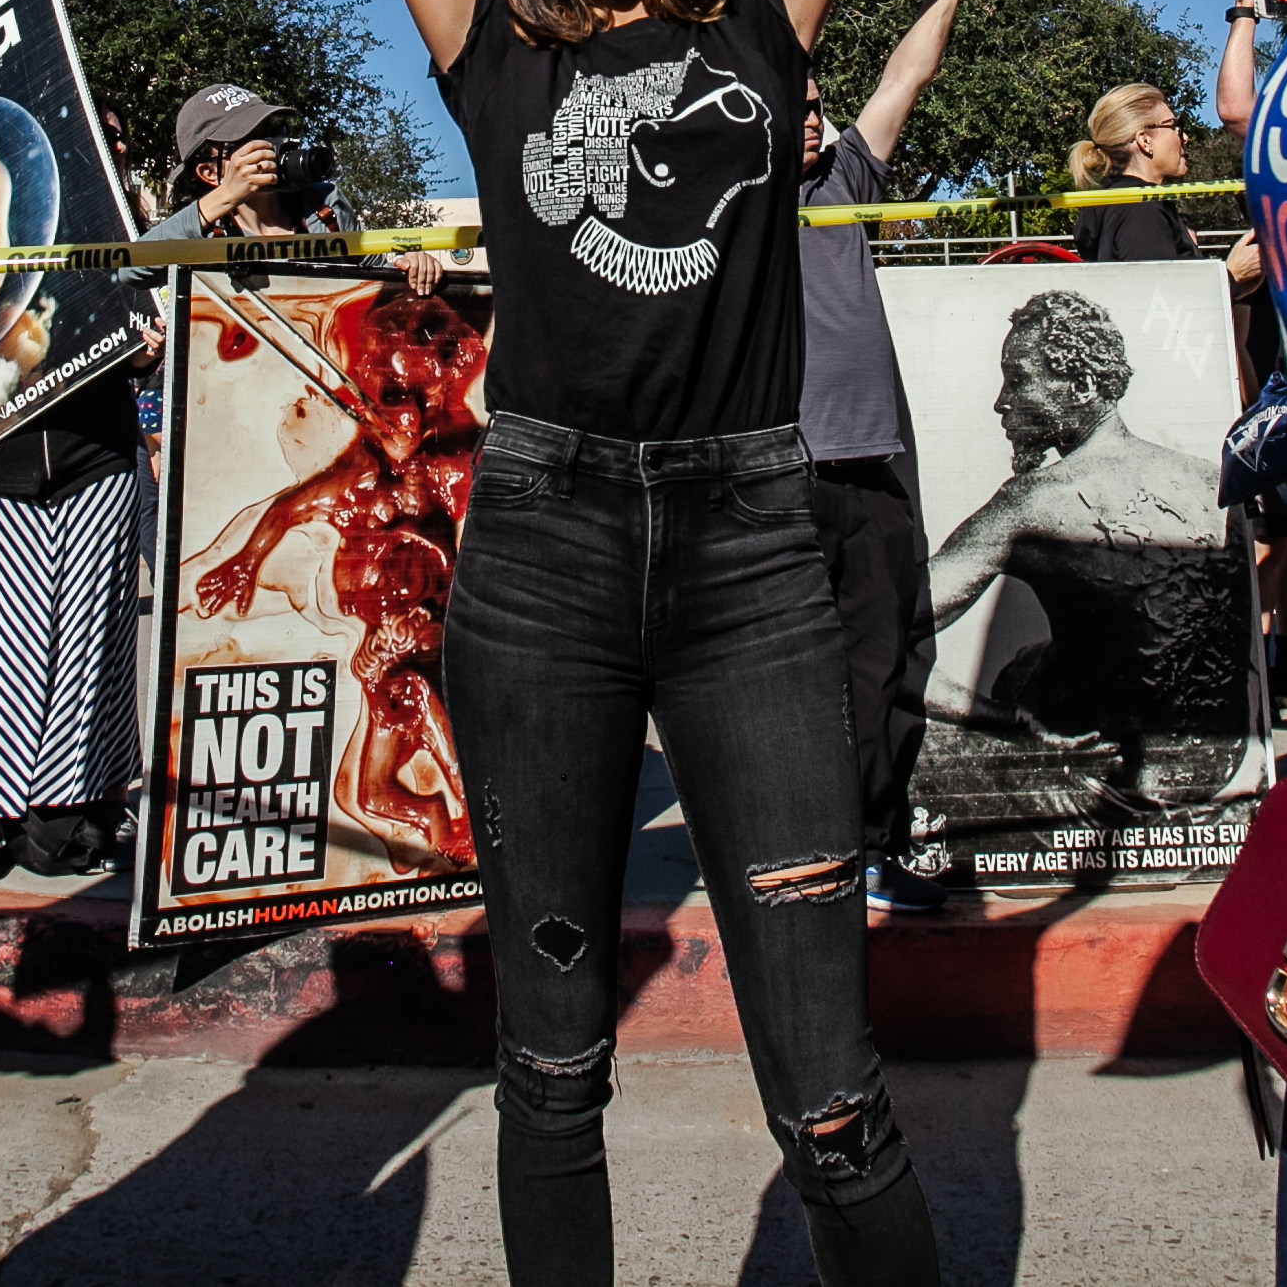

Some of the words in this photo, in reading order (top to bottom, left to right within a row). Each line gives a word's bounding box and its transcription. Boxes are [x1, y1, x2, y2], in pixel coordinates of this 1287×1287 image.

[586, 104, 639, 119] FEMINIST
[552, 107, 570, 156] RIGHTS
[567, 104, 586, 145] EQUAL
[585, 116, 631, 137] VOTE
[584, 136, 629, 149] DISSENT
[523, 158, 552, 173] FEMINIST
[567, 146, 586, 197] RIGHTS
[585, 164, 630, 183] FIGHT
[523, 169, 554, 195] VOTE
[553, 159, 570, 198] CIVIL
[587, 182, 606, 194] FOR
[608, 182, 628, 194] THE
[592, 193, 628, 205] THINGS
[195, 670, 279, 714] THIS
[291, 668, 327, 707] IS
[191, 711, 325, 787] NOT
[187, 781, 320, 829] HEALTH
[1053, 829, 1107, 849] EVERY
[1112, 828, 1145, 847] AGE
[1149, 826, 1184, 846] HAS
[1188, 825, 1215, 845] ITS
[1219, 824, 1249, 843] EVI
[183, 823, 317, 885] CARE
[975, 853, 1029, 873] EVERY
[1033, 851, 1068, 871] AGE
[1072, 850, 1107, 870] HAS
[1112, 849, 1138, 869] ITS
